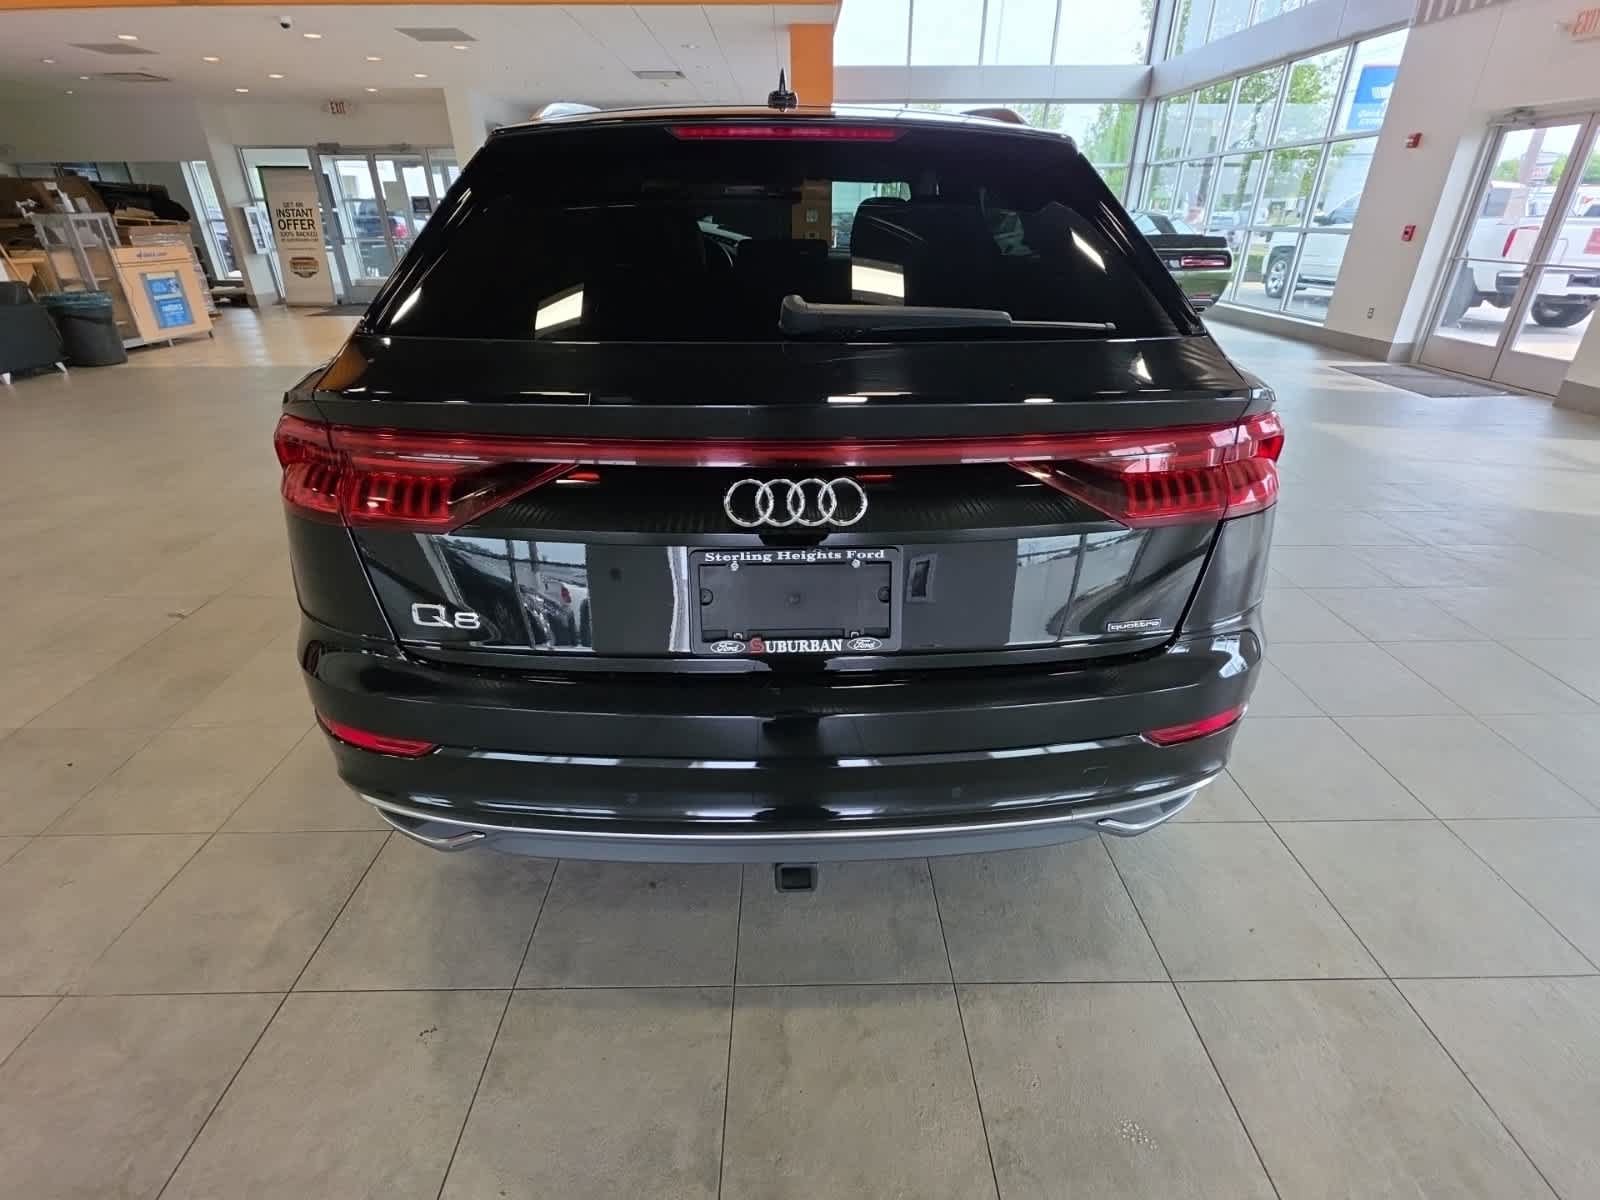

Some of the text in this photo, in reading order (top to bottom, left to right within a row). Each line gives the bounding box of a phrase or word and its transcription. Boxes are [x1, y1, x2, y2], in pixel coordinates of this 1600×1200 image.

[330, 101, 345, 114] EXIT
[276, 208, 313, 218] INSTANT
[278, 218, 316, 231] OFFER
[705, 549, 884, 563] Sterling Heights Ford
[411, 603, 480, 629] Q8
[1110, 620, 1160, 631] quattro
[750, 637, 843, 654] SUBURBAN
